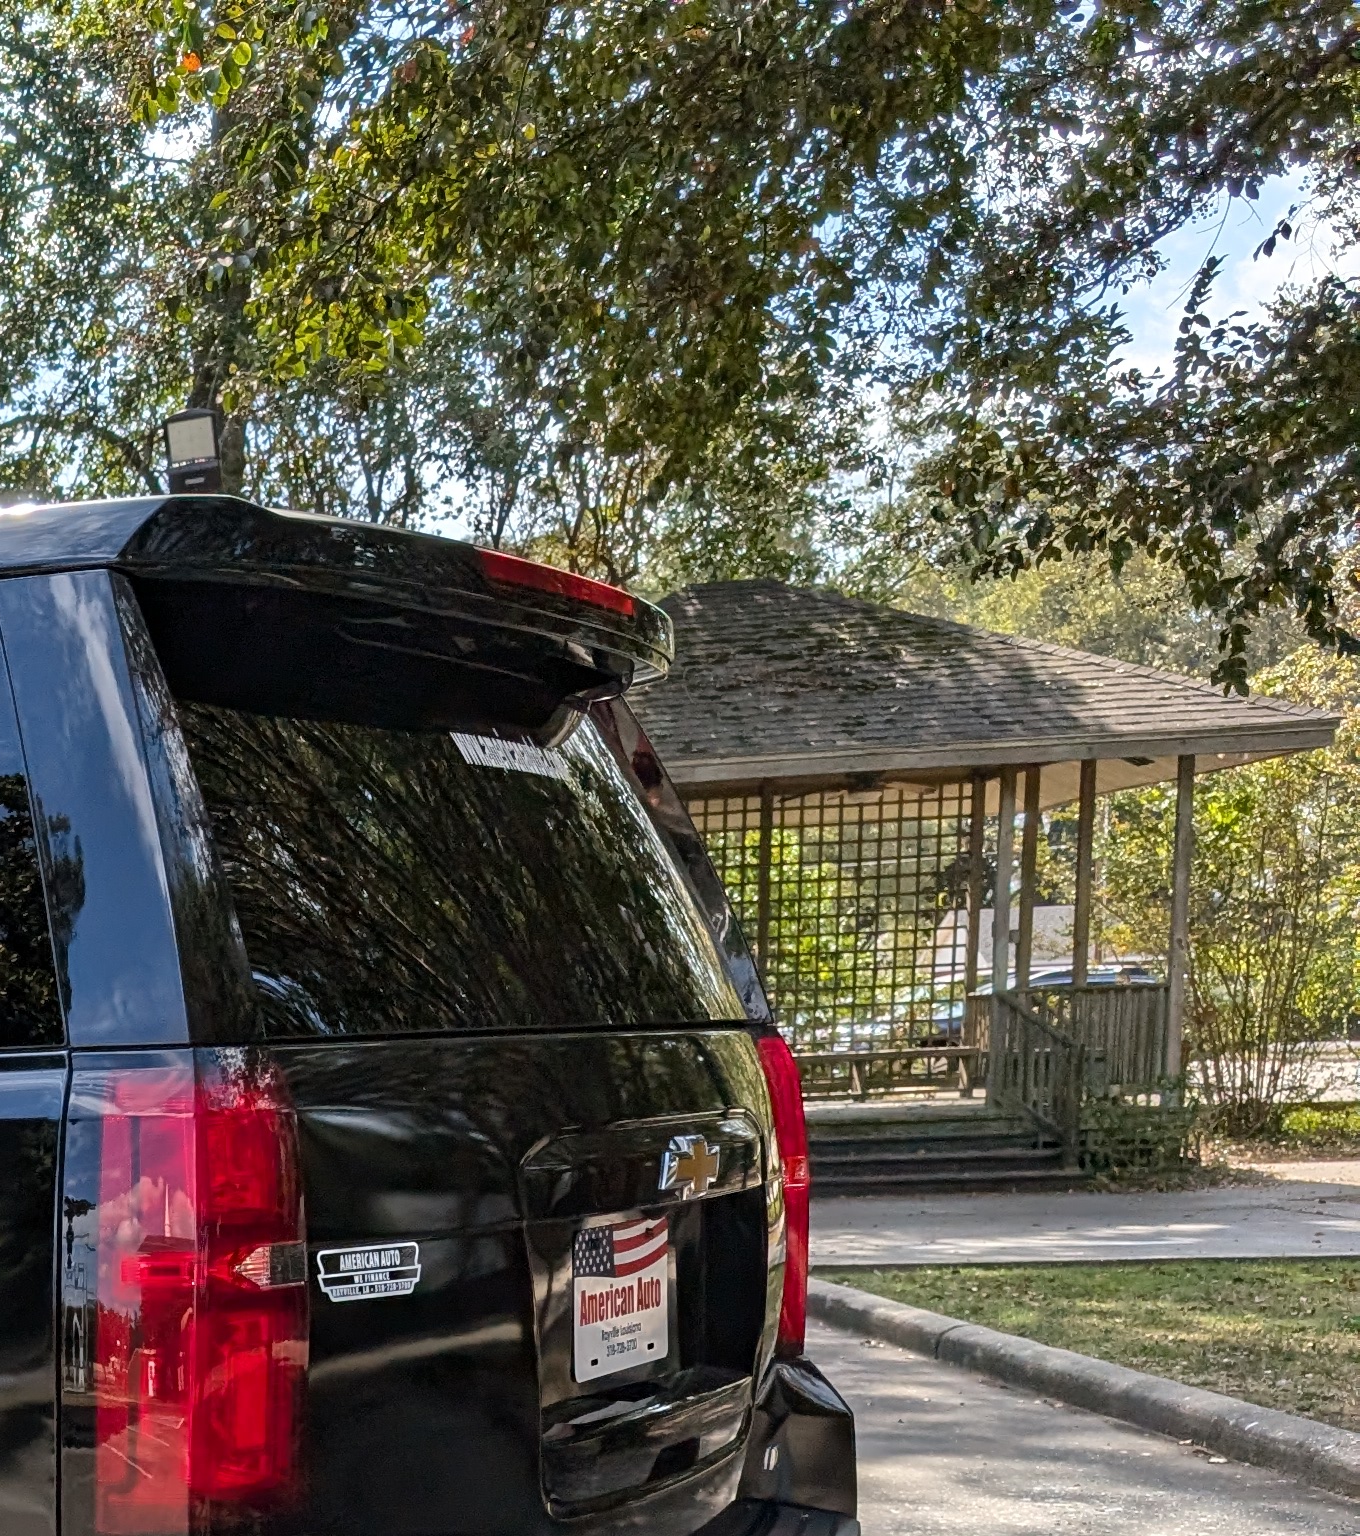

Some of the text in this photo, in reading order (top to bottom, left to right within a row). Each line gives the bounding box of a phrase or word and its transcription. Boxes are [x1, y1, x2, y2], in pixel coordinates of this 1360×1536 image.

[339, 1249, 401, 1271] AMERICAN AUTO
[364, 1271, 390, 1283] FINANCE
[580, 1276, 661, 1327] American Auto
